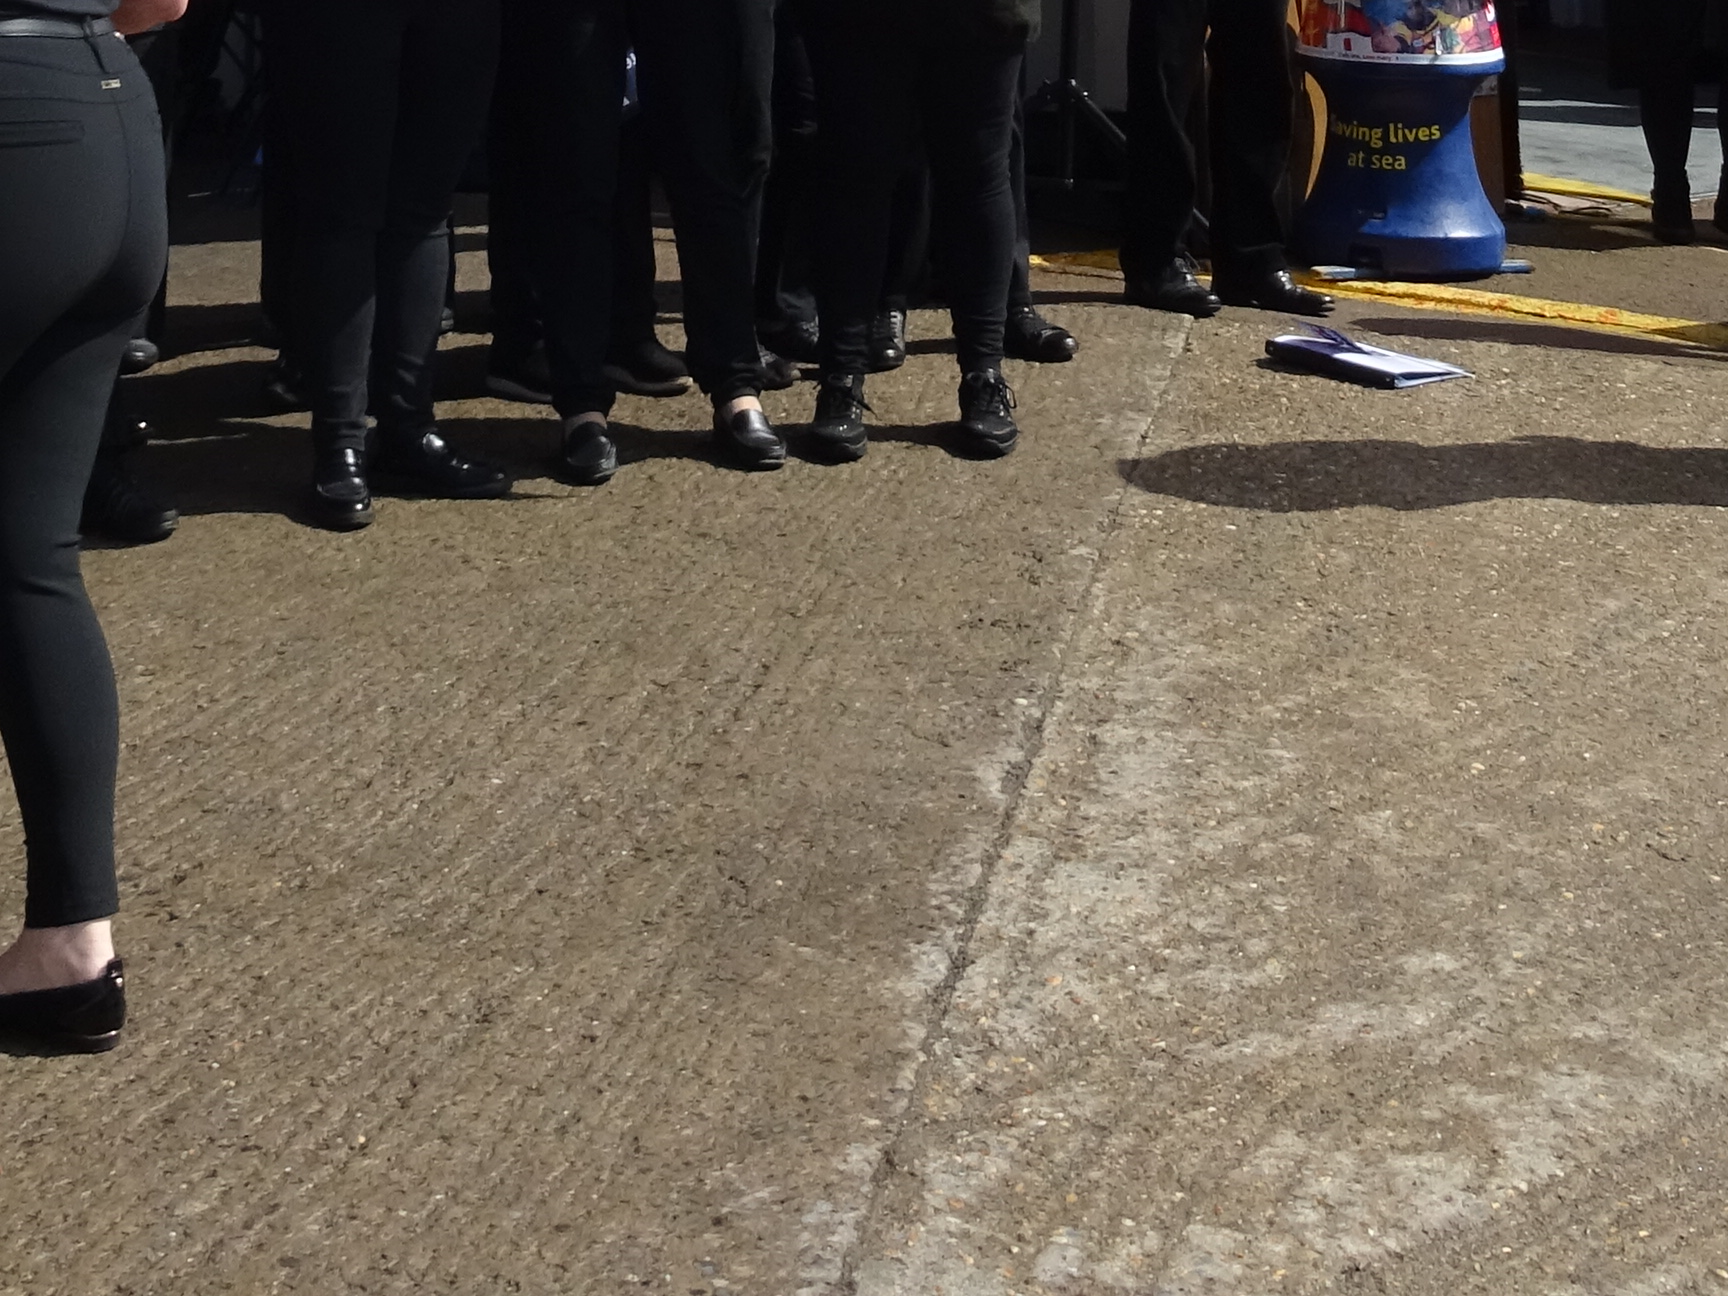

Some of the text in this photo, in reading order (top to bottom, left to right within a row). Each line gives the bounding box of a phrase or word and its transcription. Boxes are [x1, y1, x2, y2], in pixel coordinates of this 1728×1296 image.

[1332, 115, 1441, 149] aving lives
[1347, 150, 1406, 170] at sea
